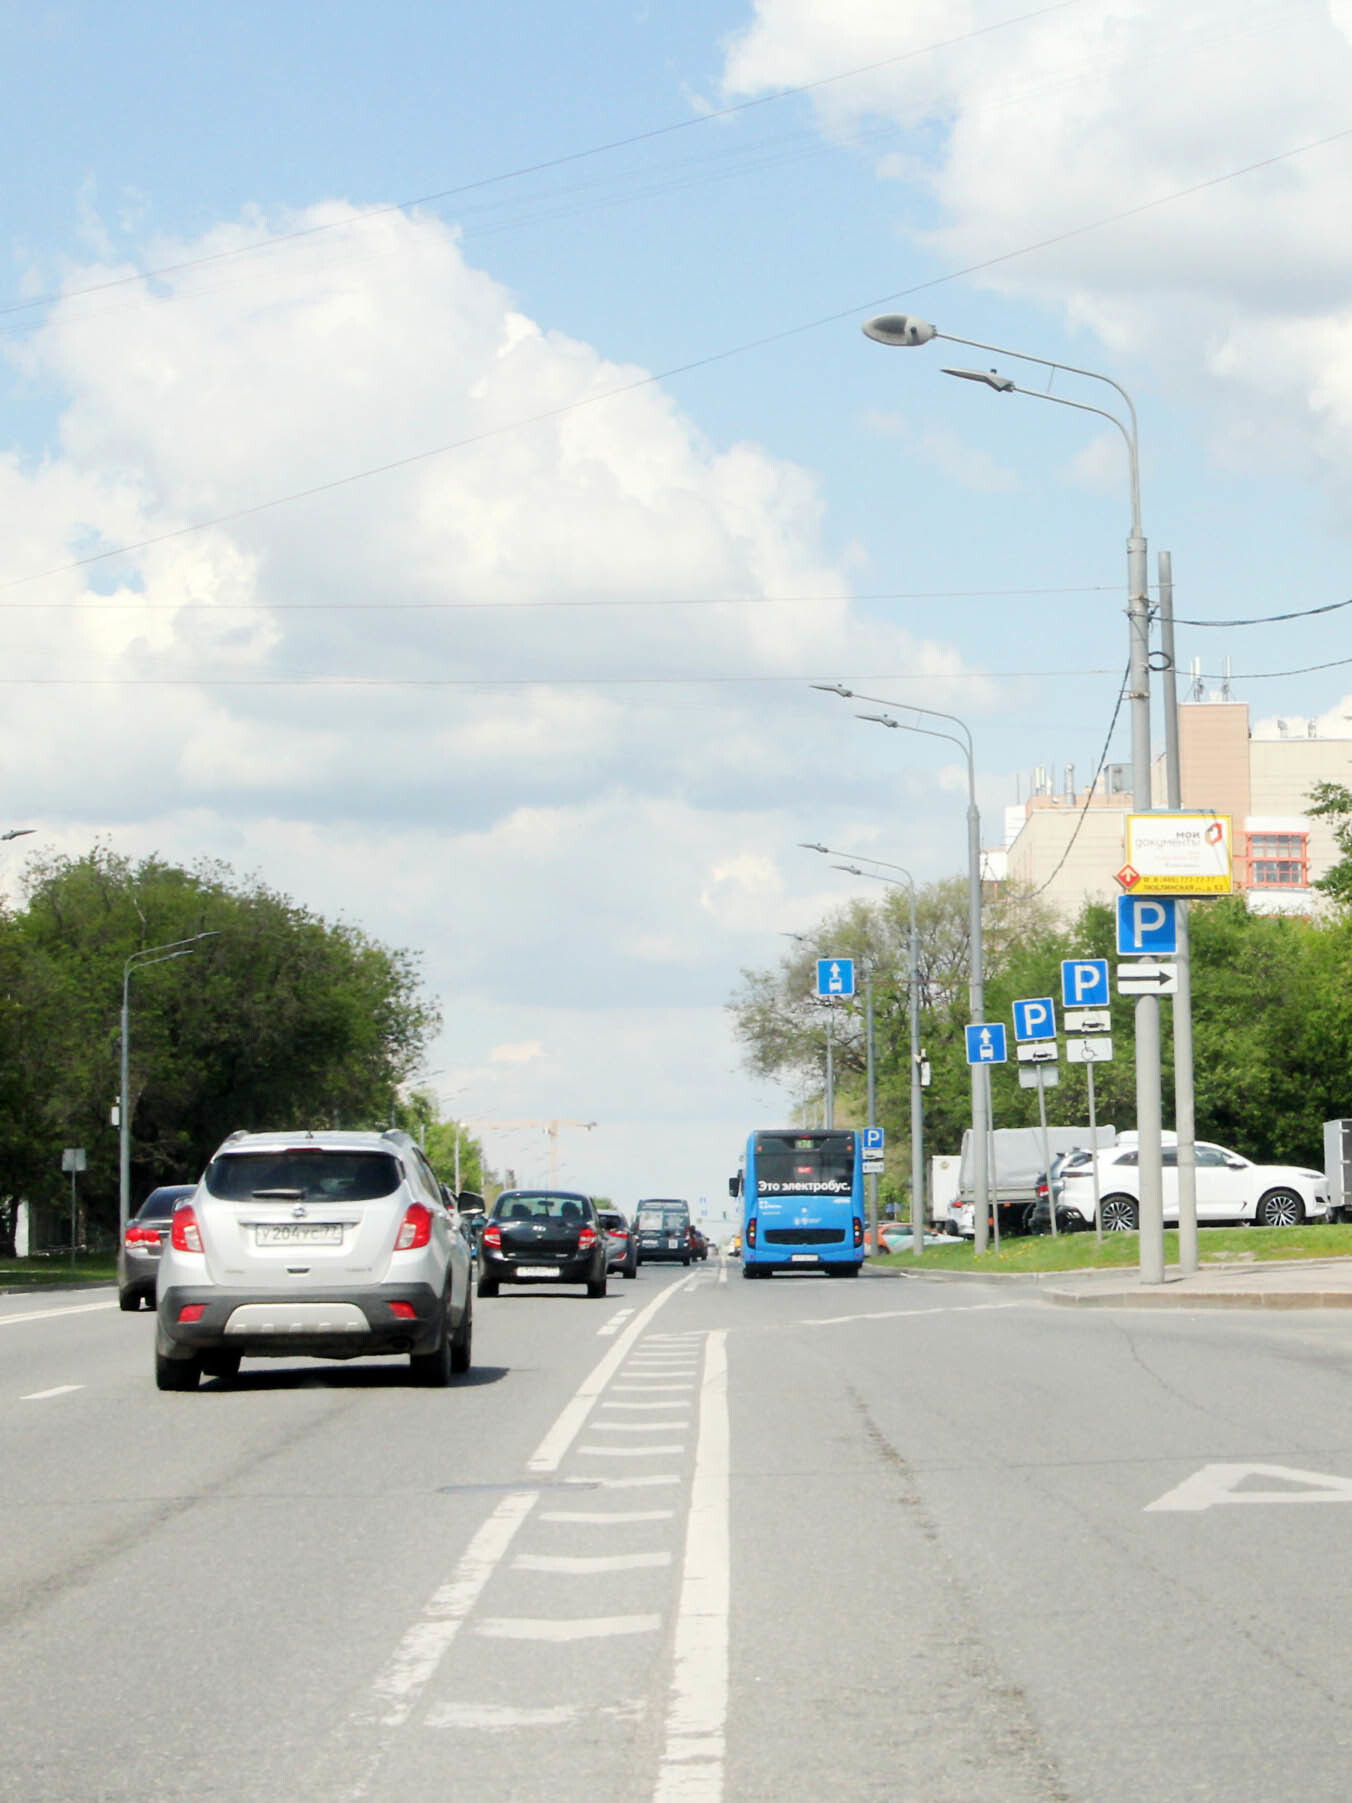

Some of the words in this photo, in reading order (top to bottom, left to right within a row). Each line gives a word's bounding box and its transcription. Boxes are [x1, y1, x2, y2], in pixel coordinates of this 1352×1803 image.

[1133, 902, 1166, 948] P
[1075, 965, 1099, 1001] P
[1025, 1004, 1047, 1036] P
[867, 1130, 880, 1147] P
[758, 1180, 780, 1191] Это
[781, 1180, 851, 1193] электробус.
